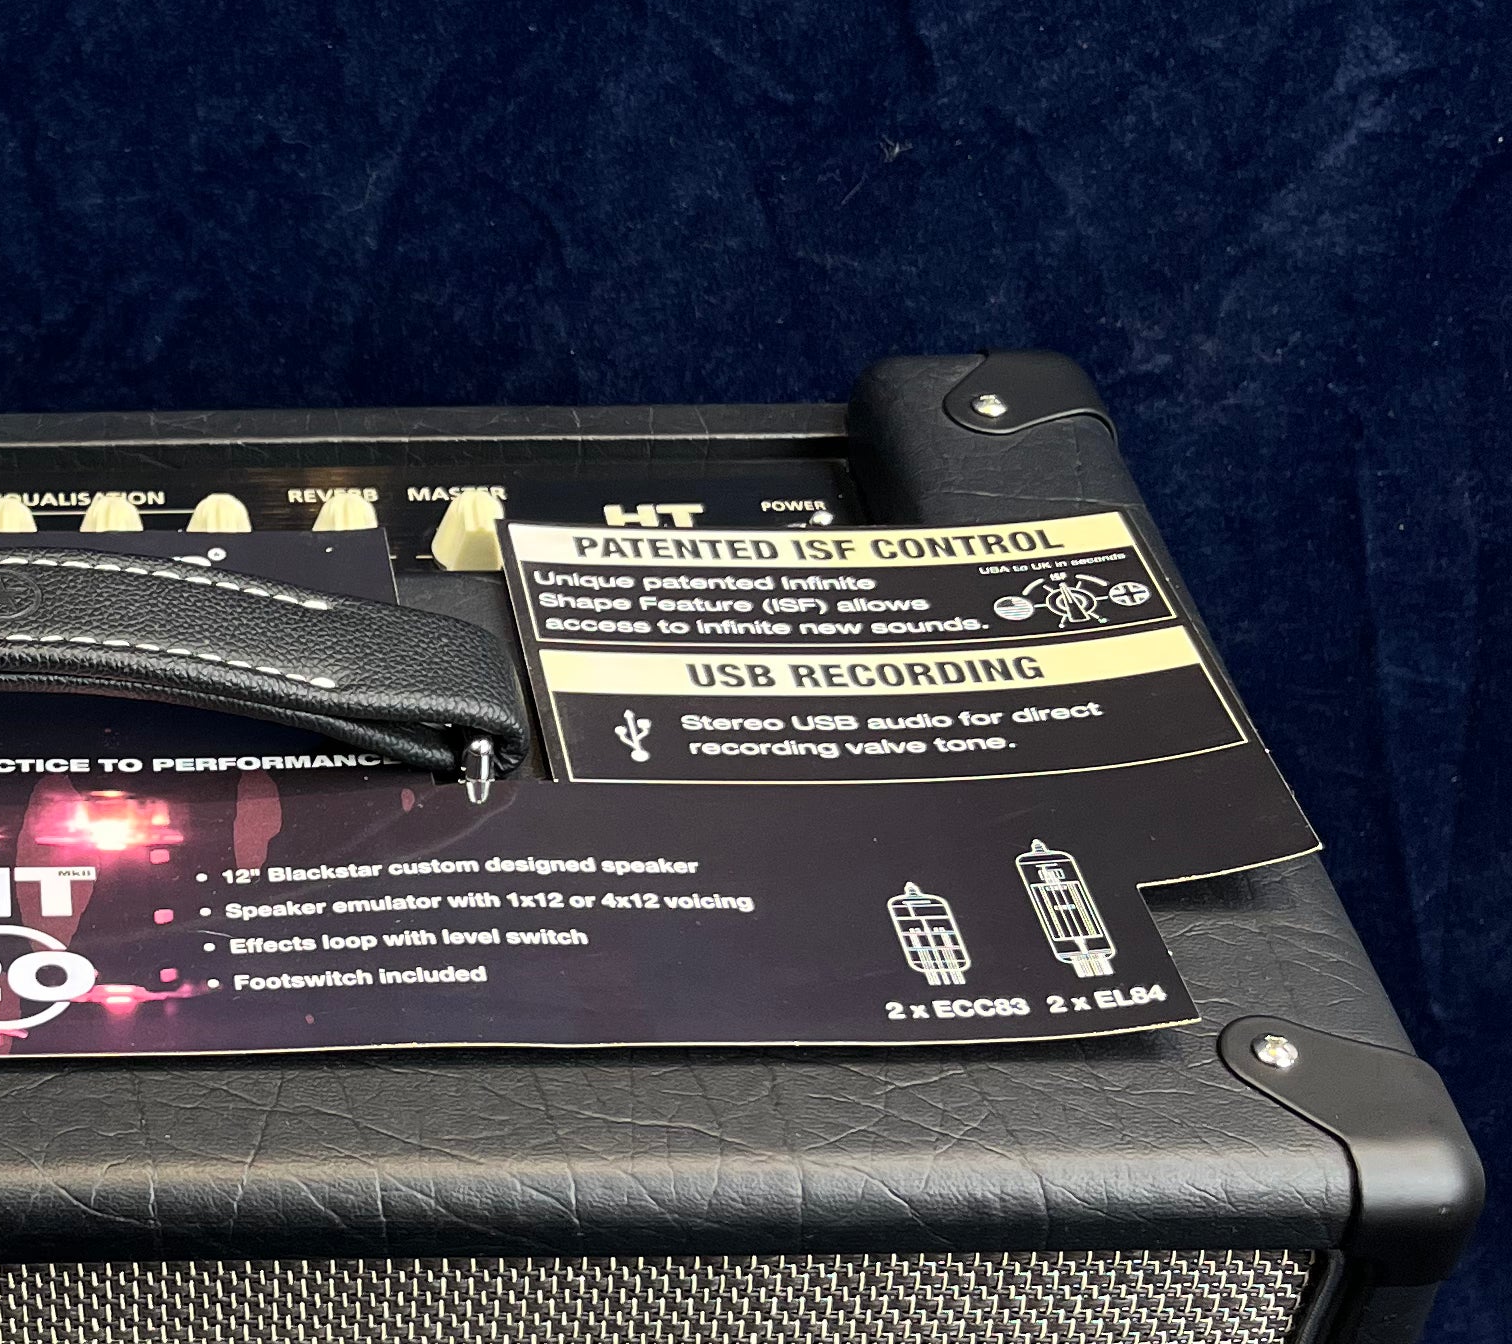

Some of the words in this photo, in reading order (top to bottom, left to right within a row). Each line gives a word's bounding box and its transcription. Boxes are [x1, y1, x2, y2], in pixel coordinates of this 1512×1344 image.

[603, 504, 703, 527] HT
[761, 500, 826, 512] POWER
[573, 536, 778, 561] PATENTED
[791, 538, 856, 561] ISF
[870, 529, 1064, 561] CONTROL
[533, 571, 635, 589] Unique
[643, 574, 774, 592] patented
[538, 592, 633, 611] Shape
[639, 595, 753, 612] Feature
[763, 597, 828, 614] (ISF)
[837, 598, 931, 613] allows
[545, 616, 651, 633] access
[657, 619, 690, 634] to
[799, 621, 863, 635] new
[871, 616, 989, 635] sounds.
[685, 662, 776, 689] USB
[787, 656, 1045, 689] RECORDING
[681, 713, 785, 732] Stereo
[791, 714, 858, 732] USB
[867, 712, 954, 731] audio
[958, 709, 1003, 728] for
[1011, 702, 1104, 724] direct
[689, 739, 840, 759] recording
[844, 737, 928, 756] valve
[933, 734, 1017, 754] tone.
[98, 758, 143, 773] TO
[267, 863, 383, 883] Blackstar
[388, 858, 480, 875] custom
[485, 856, 597, 875] designed
[601, 858, 699, 876] speaker
[225, 900, 326, 921] Speaker
[332, 894, 442, 914] emulator
[447, 891, 501, 908] with
[506, 891, 564, 908] 1x12
[569, 894, 596, 908] or
[601, 892, 660, 909] 4x12
[663, 893, 755, 913] voicing
[230, 935, 317, 954] Effects
[322, 933, 378, 950] loop
[382, 929, 437, 947] with
[442, 927, 501, 946] level
[506, 928, 589, 945] switch
[234, 969, 374, 991] Footswitch
[379, 965, 488, 985] included
[885, 1001, 906, 1020] 2
[910, 1004, 930, 1019] x
[932, 997, 1031, 1019] ECC83
[1046, 995, 1067, 1014] 2
[1071, 995, 1091, 1011] x
[1094, 984, 1168, 1009] EL84
